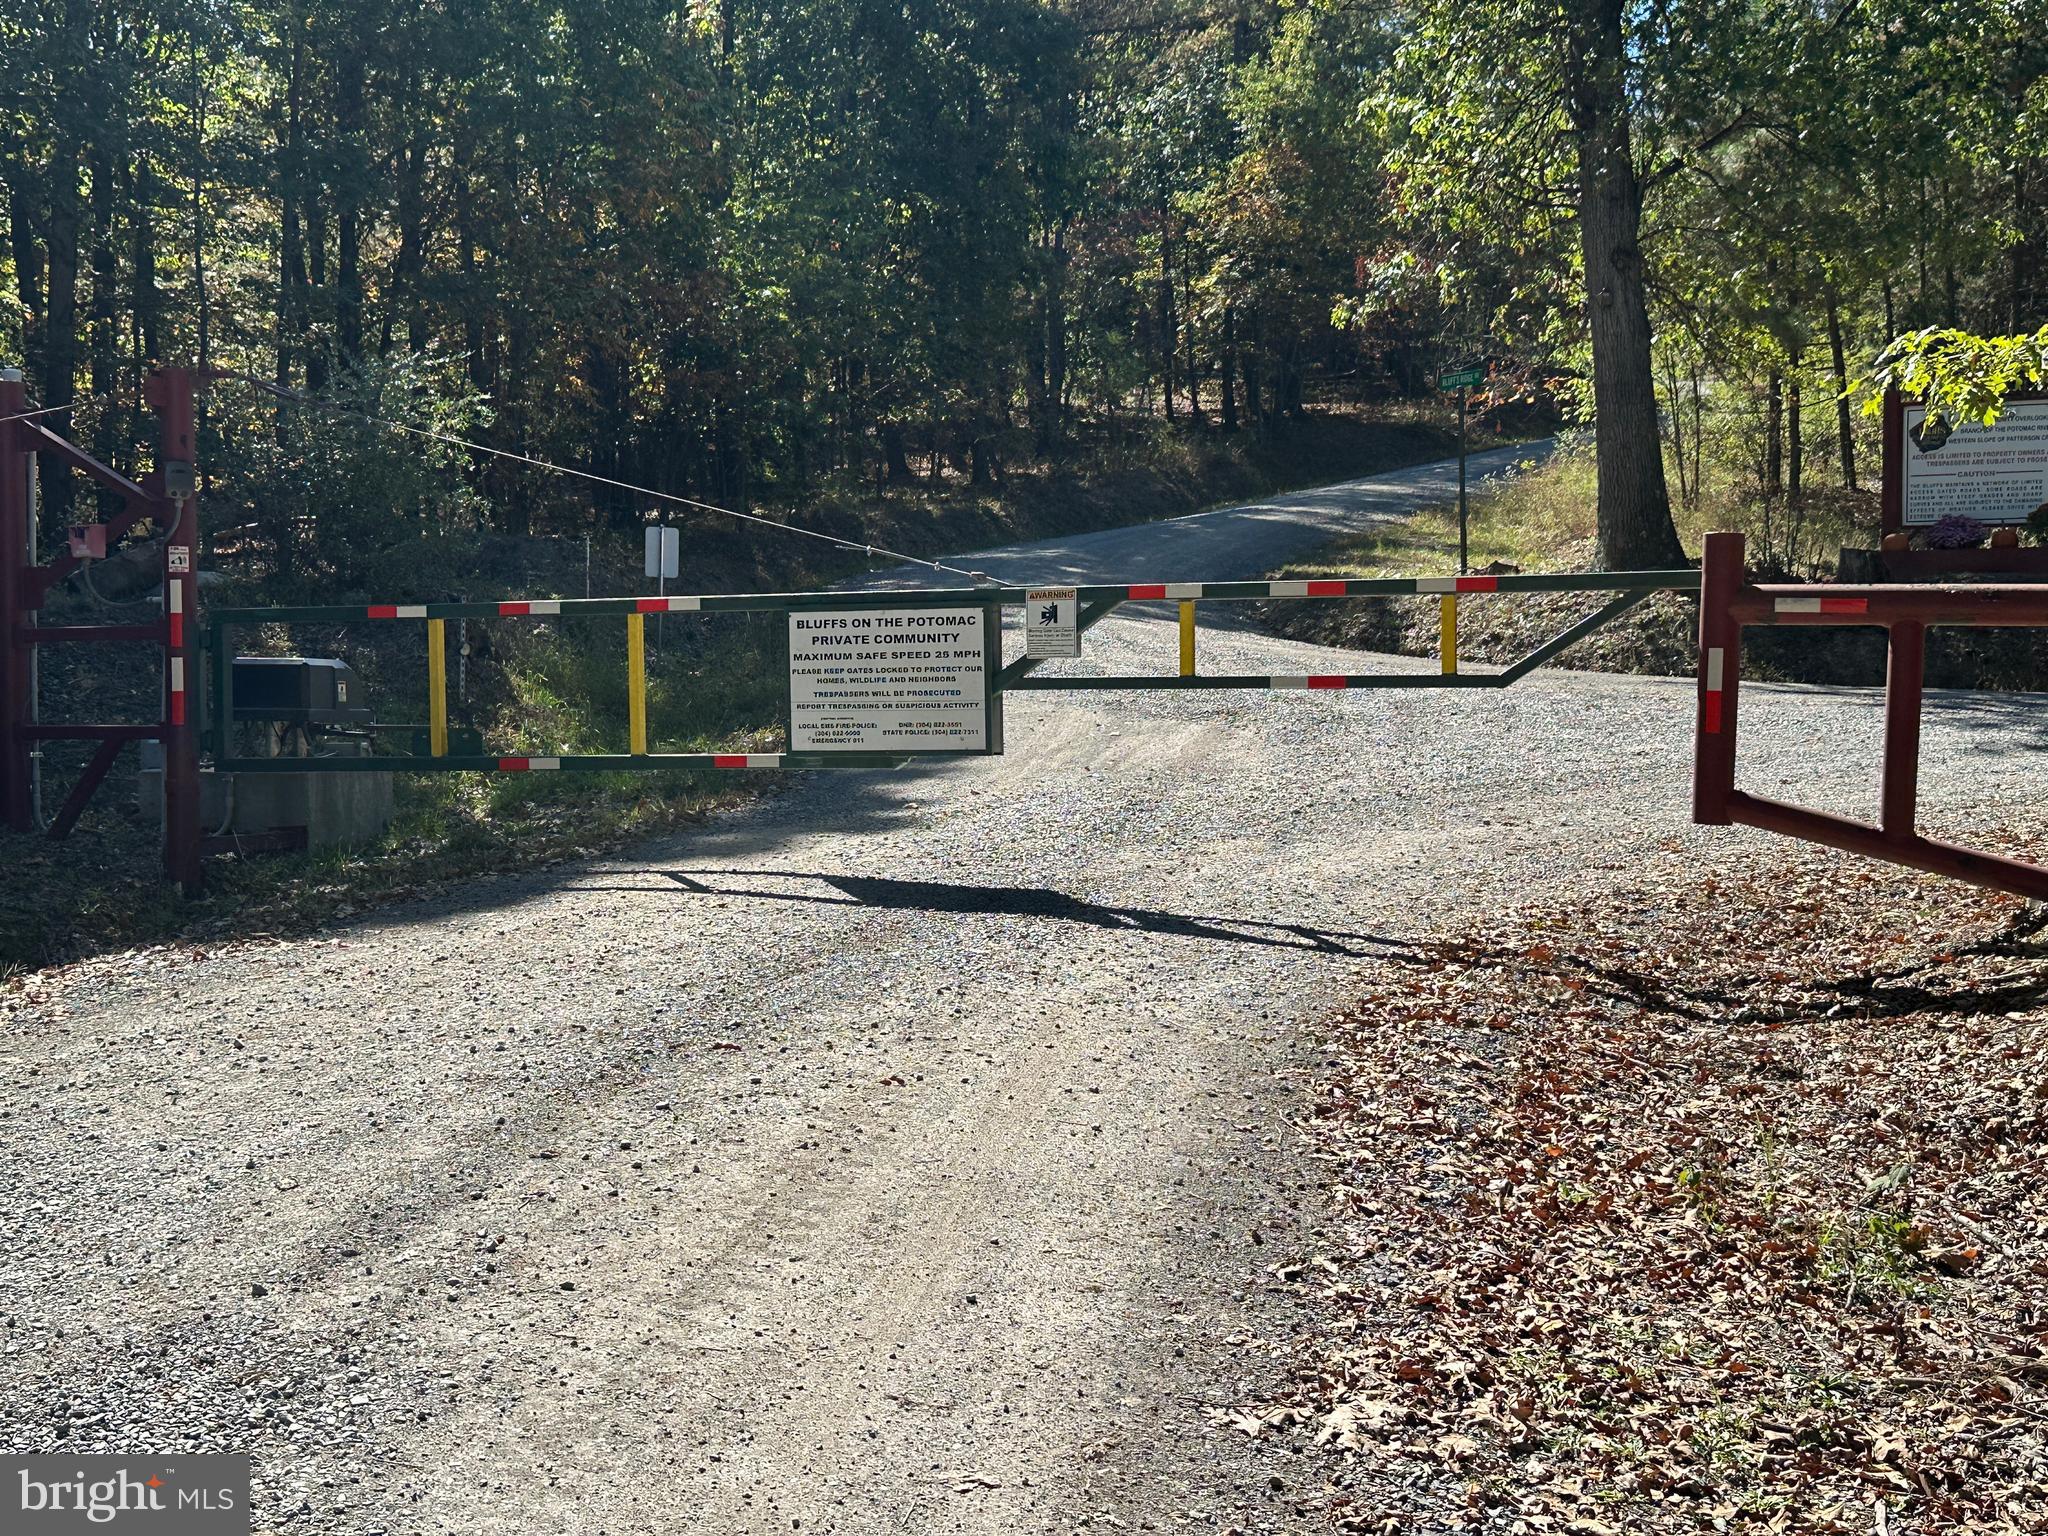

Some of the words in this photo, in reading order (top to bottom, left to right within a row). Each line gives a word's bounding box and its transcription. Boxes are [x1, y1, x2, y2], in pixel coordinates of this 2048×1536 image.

[1957, 470, 1996, 478] CAUTION
[1034, 591, 1074, 599] WARNING
[796, 619, 847, 629] BLUFFS
[852, 618, 871, 628] ON
[875, 618, 903, 628] THE
[907, 616, 976, 627] POTOMAC
[812, 634, 870, 646] PRIVATE
[874, 633, 960, 644] COMMUNITY
[793, 652, 852, 661] MAXIMUM
[856, 652, 888, 660] SAFE
[891, 651, 931, 660] SPEED
[935, 650, 950, 659] 25
[953, 650, 981, 658] MPH
